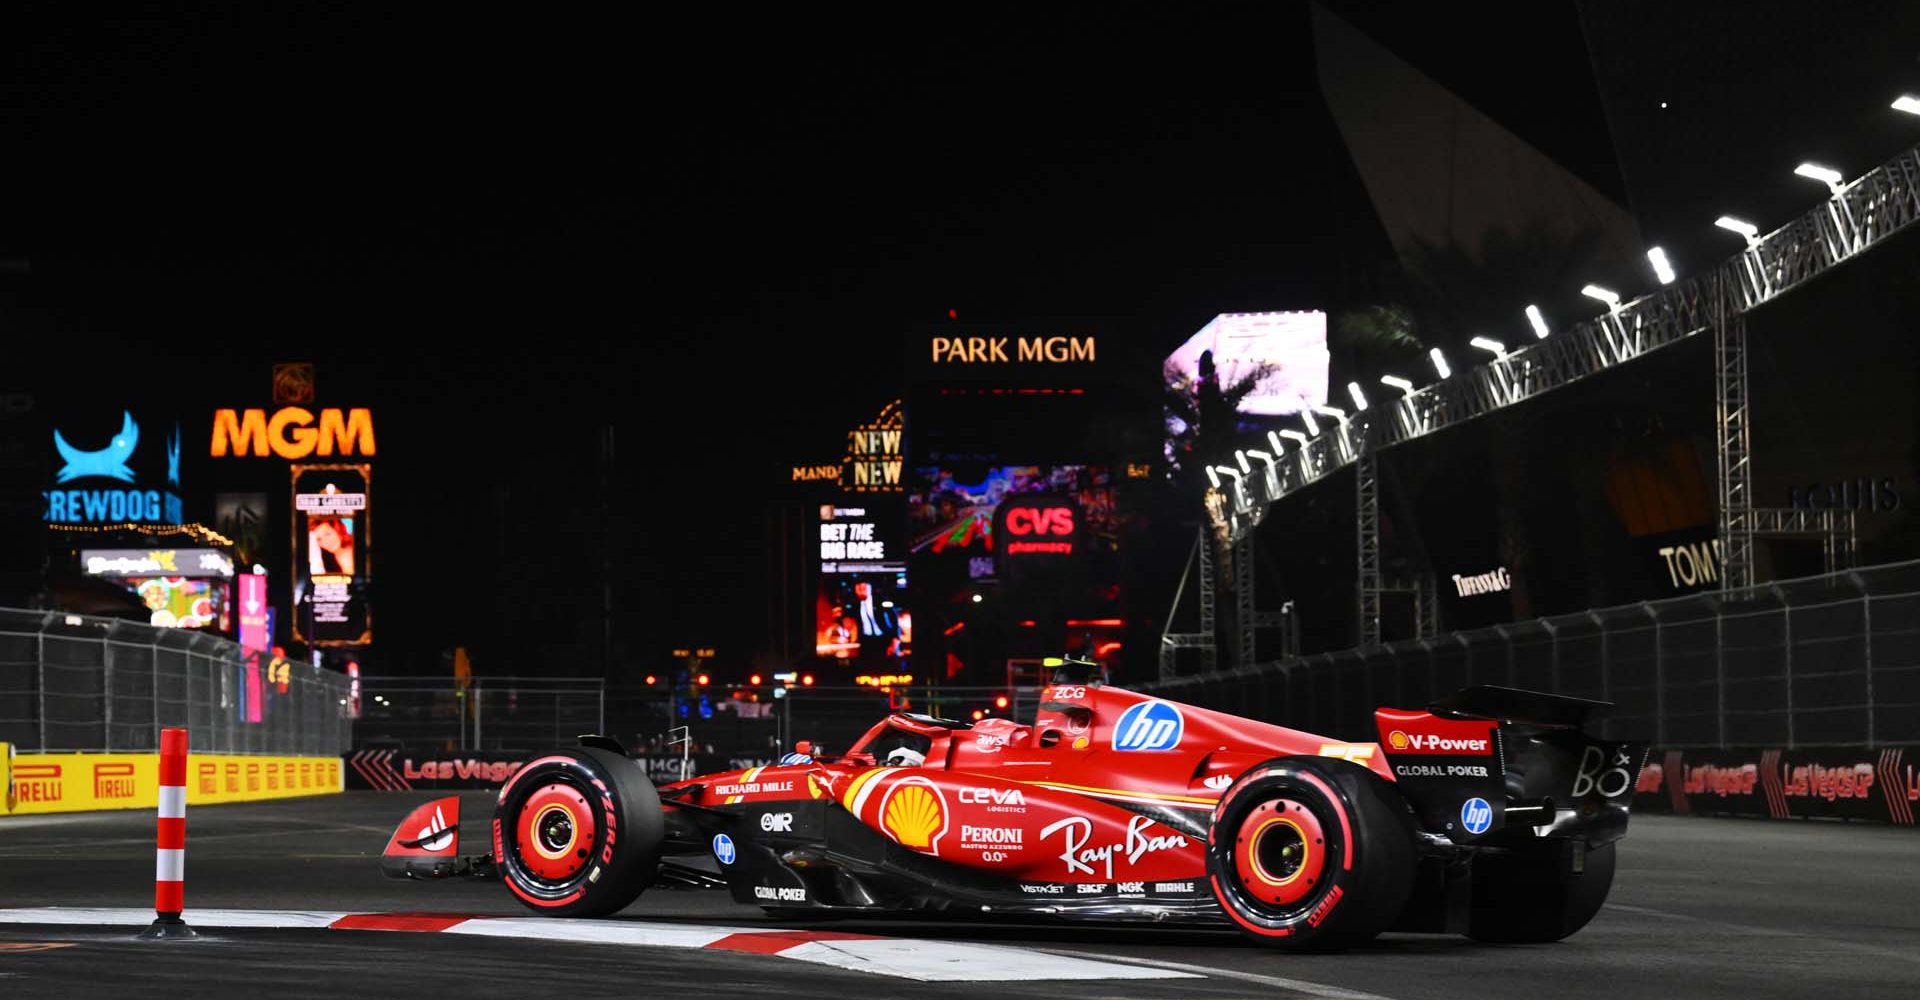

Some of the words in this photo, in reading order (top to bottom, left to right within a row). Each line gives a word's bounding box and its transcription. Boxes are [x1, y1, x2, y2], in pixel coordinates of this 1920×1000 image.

[932, 337, 1008, 362] PARK
[1018, 337, 1095, 362] MGM
[211, 406, 376, 459] MGM
[855, 431, 901, 454] NEW
[793, 466, 842, 481] MAND
[855, 461, 902, 485] NEW
[1006, 507, 1075, 536] CVS
[820, 523, 848, 541] BET
[849, 523, 875, 541] THE
[1007, 542, 1072, 555] pharmacy
[1053, 687, 1086, 699] ZCG
[1119, 702, 1178, 750] hp
[1408, 734, 1488, 751] V-Power
[1397, 765, 1446, 776] GLOBAL
[1447, 765, 1488, 777] POKER
[94, 763, 134, 799] PIRELLI
[715, 783, 760, 795] RICHARD
[762, 781, 794, 792] MILLE
[1465, 798, 1489, 832] hp
[601, 795, 617, 865] ZERO
[961, 825, 1024, 844] PERONI
[778, 888, 806, 901] POKER
[1117, 882, 1145, 893] NGK
[1155, 882, 1195, 893] MAHLE
